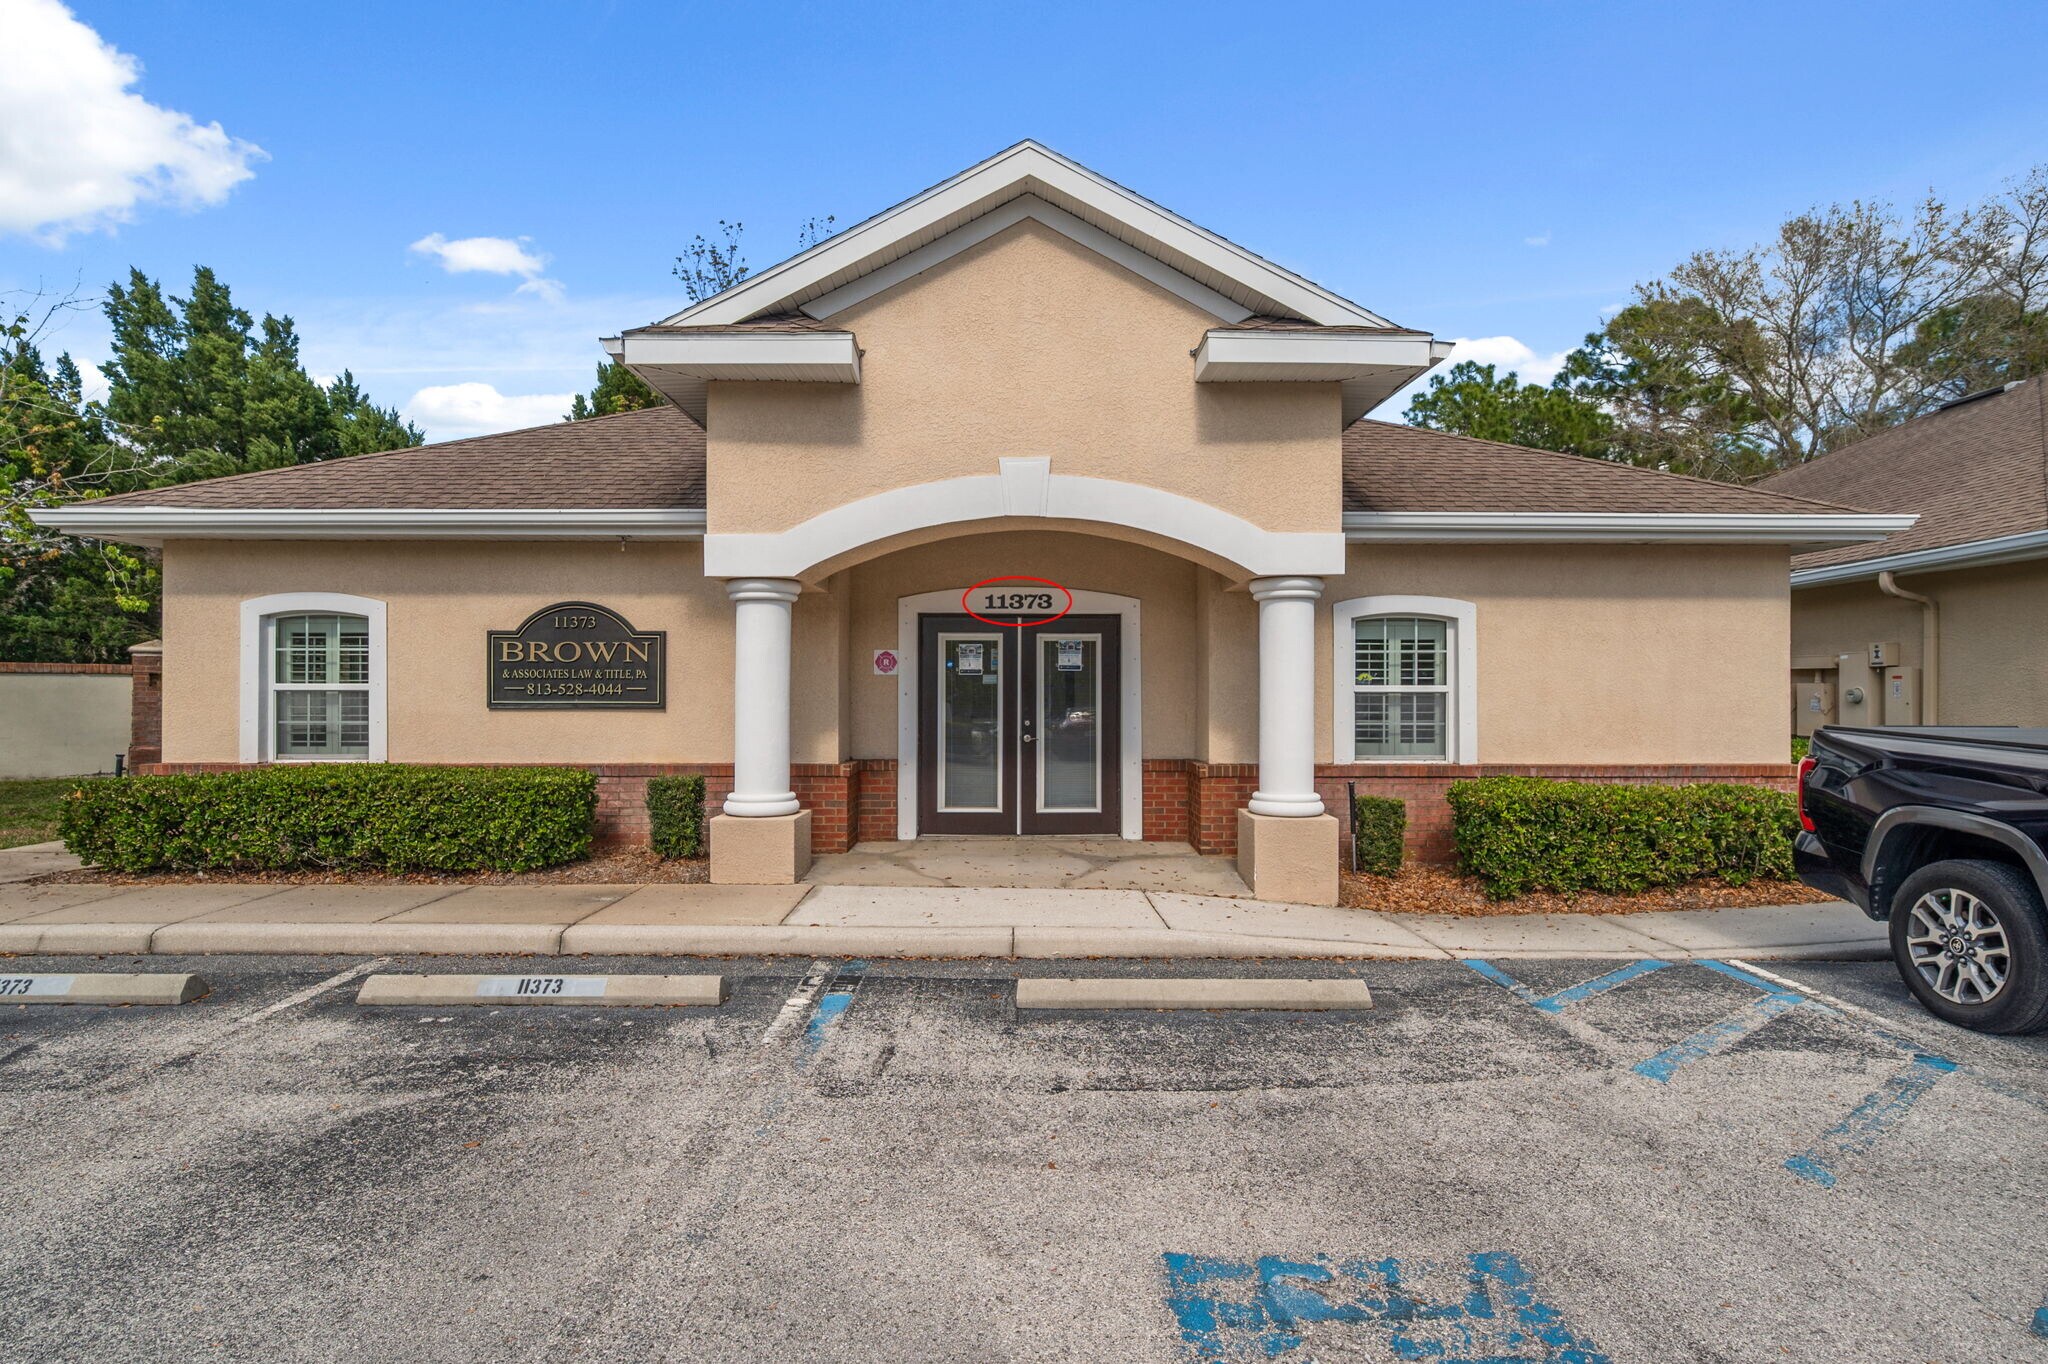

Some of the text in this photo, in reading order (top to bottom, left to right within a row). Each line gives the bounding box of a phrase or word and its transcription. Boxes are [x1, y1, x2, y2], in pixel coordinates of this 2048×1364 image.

[985, 594, 1053, 609] 11373
[554, 616, 596, 629] 11373
[499, 641, 652, 663] BROWN
[502, 668, 648, 680] & ASSOCIATES LAW & TITLE, PA
[527, 682, 623, 695] 813-528-4044
[0, 978, 34, 995] 373
[517, 978, 564, 995] 11373
